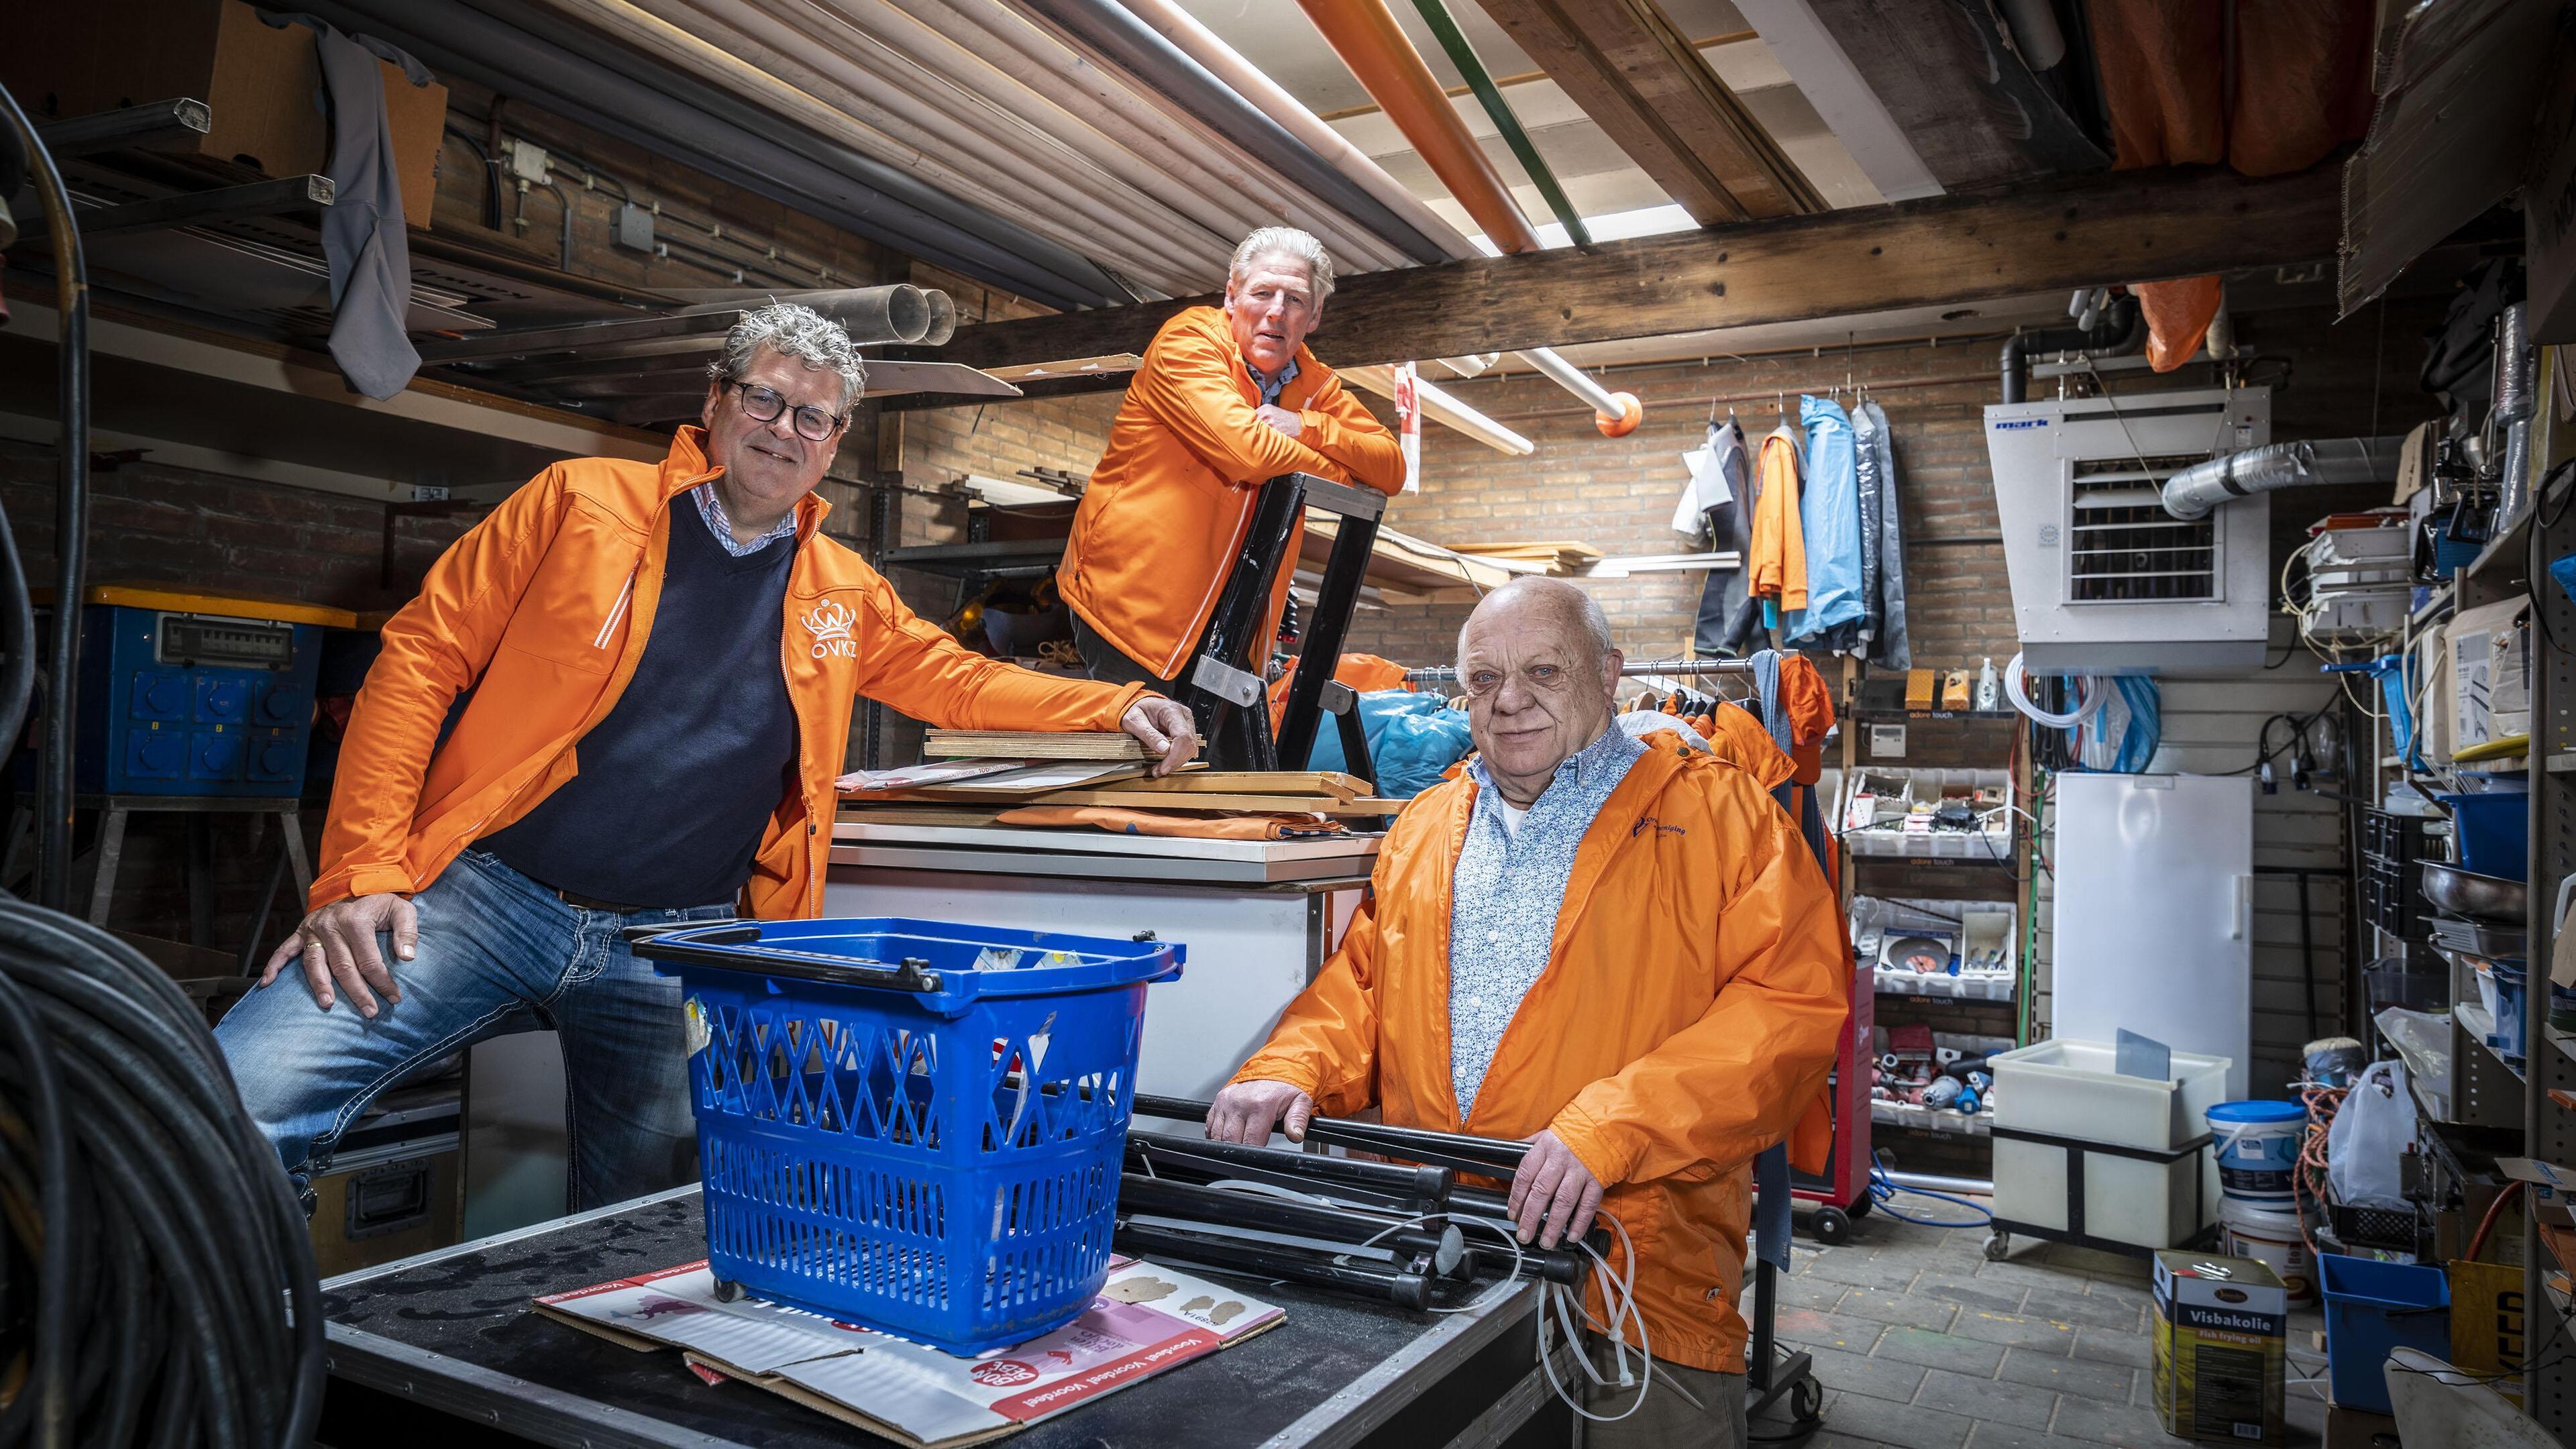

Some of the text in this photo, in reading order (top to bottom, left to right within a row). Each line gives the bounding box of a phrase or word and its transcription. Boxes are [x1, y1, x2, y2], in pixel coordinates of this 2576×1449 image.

[1996, 419, 2049, 430] mark
[811, 639, 857, 659] OVKZ
[1932, 711, 1953, 719] touch
[1932, 997, 1953, 1006] touch
[2190, 1310, 2271, 1331] Visbakolie
[2200, 1330, 2217, 1338] Fish
[2219, 1332, 2247, 1344] frying
[1022, 1338, 1202, 1407] Voordeel Voordeel Voordeel
